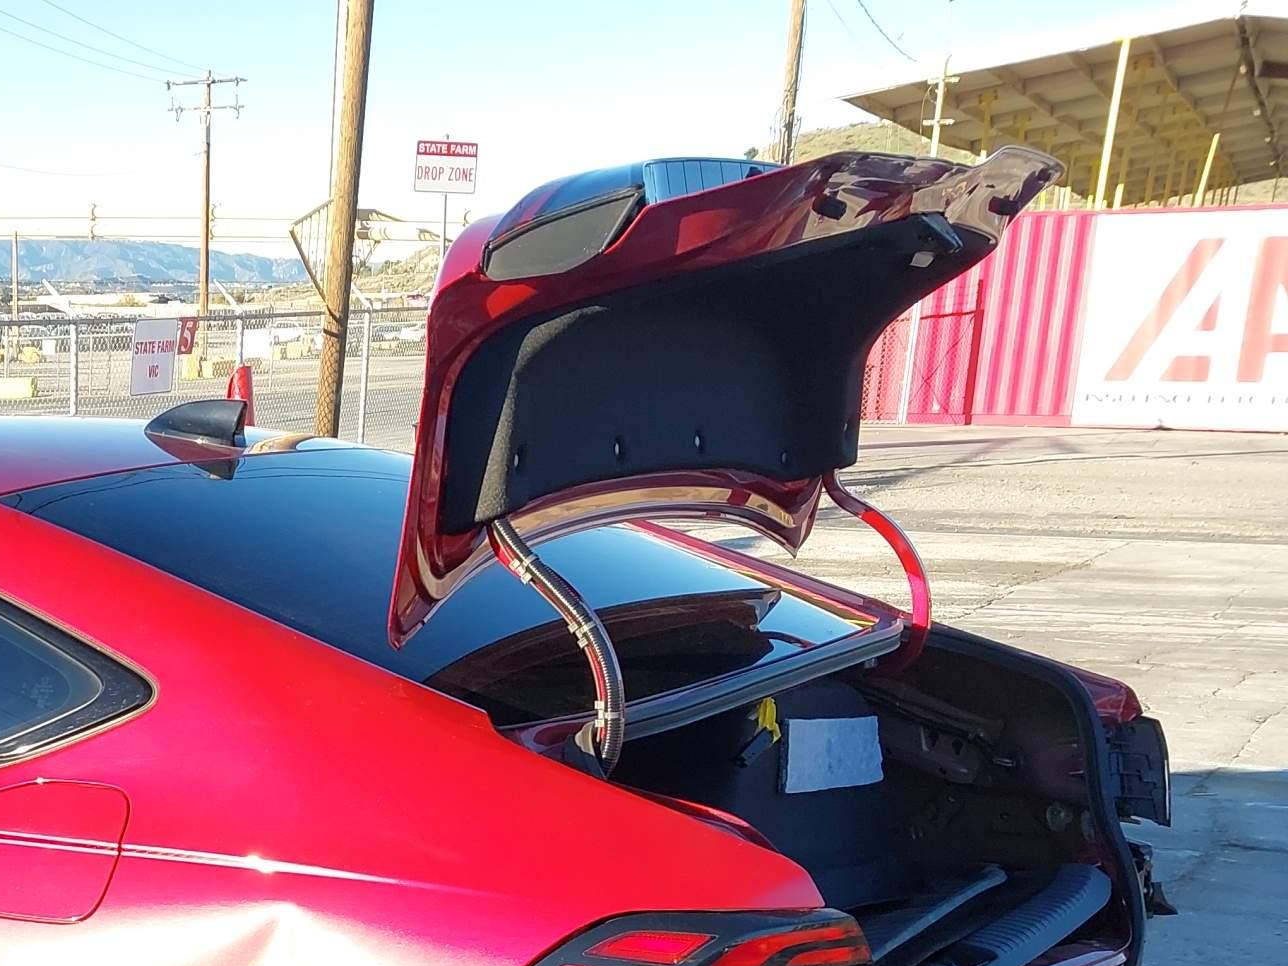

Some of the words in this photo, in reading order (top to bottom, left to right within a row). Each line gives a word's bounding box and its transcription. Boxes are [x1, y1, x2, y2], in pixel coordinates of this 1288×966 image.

[418, 142, 448, 154] STATE
[450, 144, 477, 156] FARM
[417, 165, 444, 181] DROP
[448, 167, 474, 182] ZONE
[180, 320, 194, 352] 5
[134, 340, 156, 355] STATE
[157, 339, 175, 354] FARM
[148, 364, 159, 378] VIC
